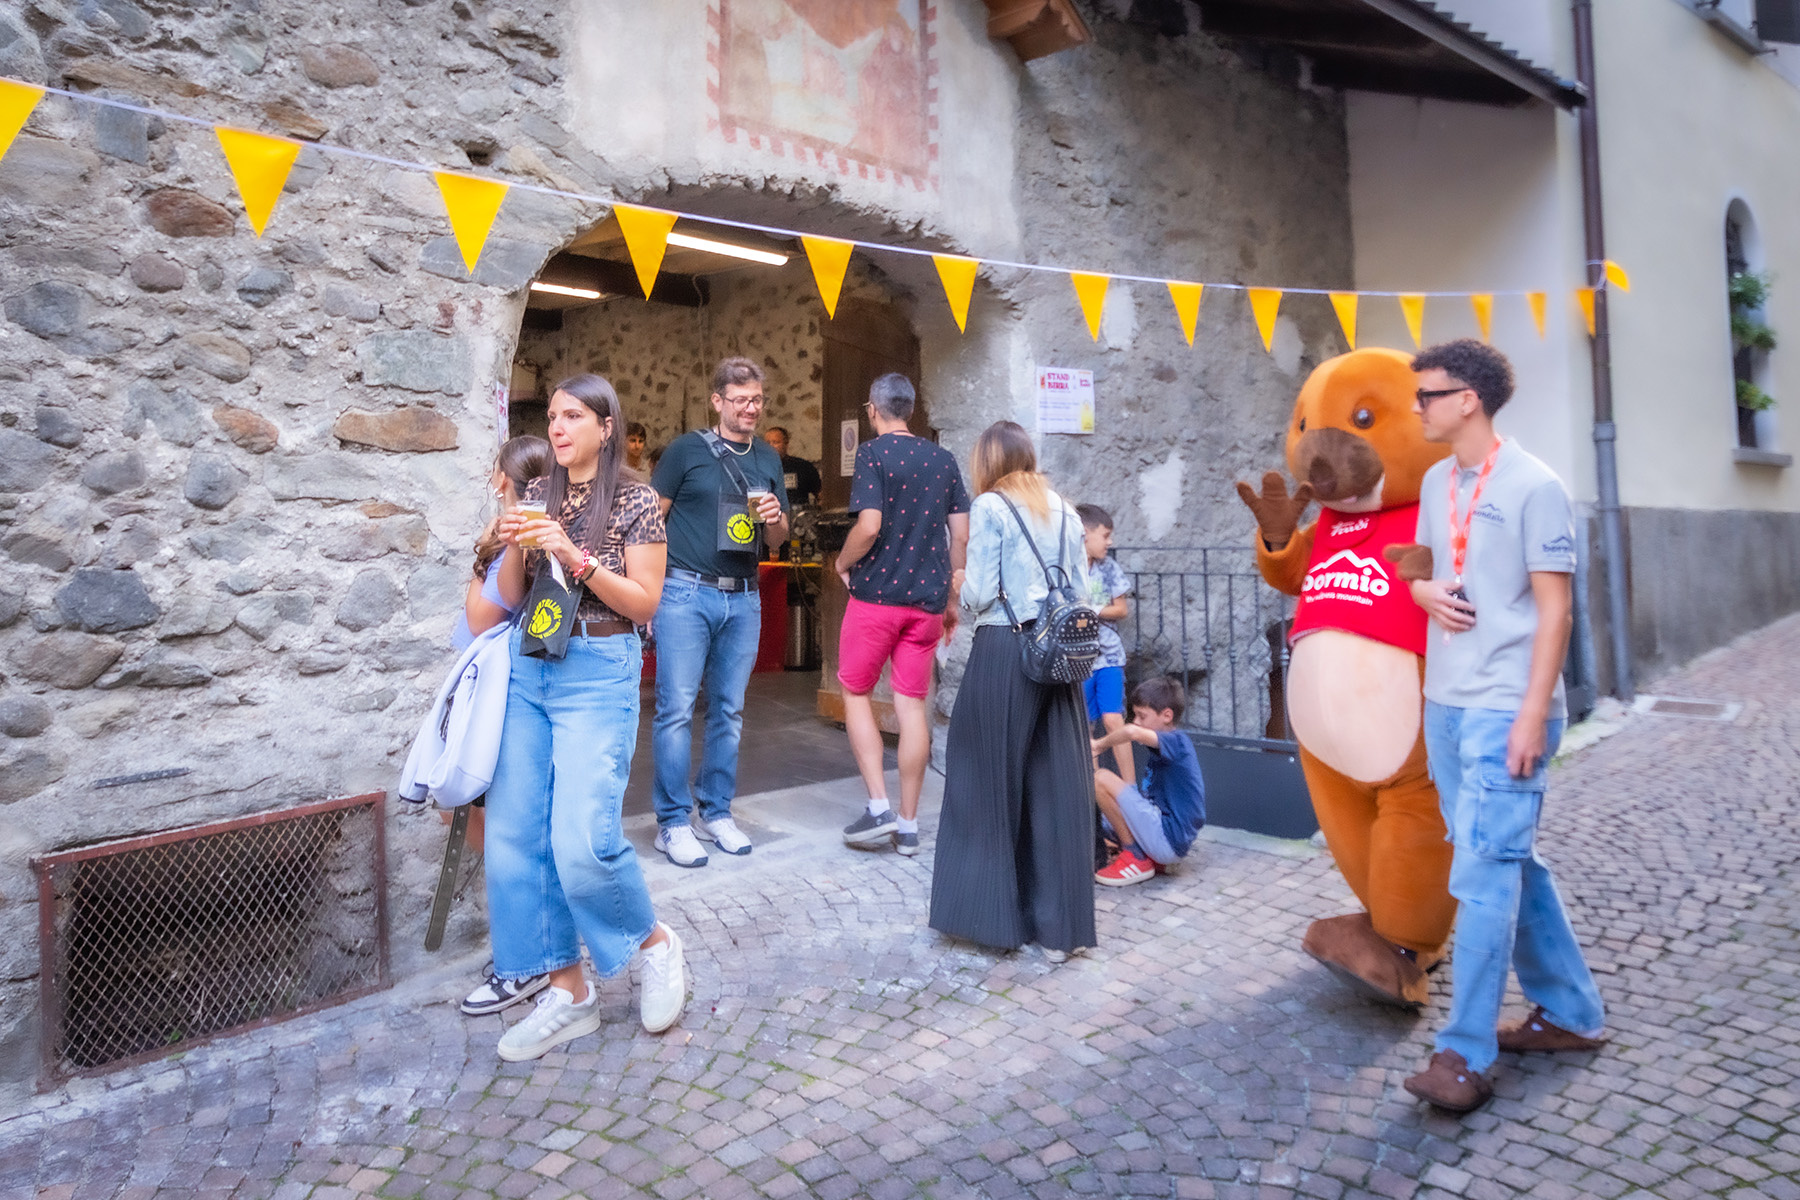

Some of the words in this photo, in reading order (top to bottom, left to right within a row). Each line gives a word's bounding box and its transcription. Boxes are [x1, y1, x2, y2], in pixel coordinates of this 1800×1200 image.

[1047, 372, 1070, 381] STAND
[1047, 381, 1069, 391] BIRRA
[1336, 592, 1374, 607] mountain
